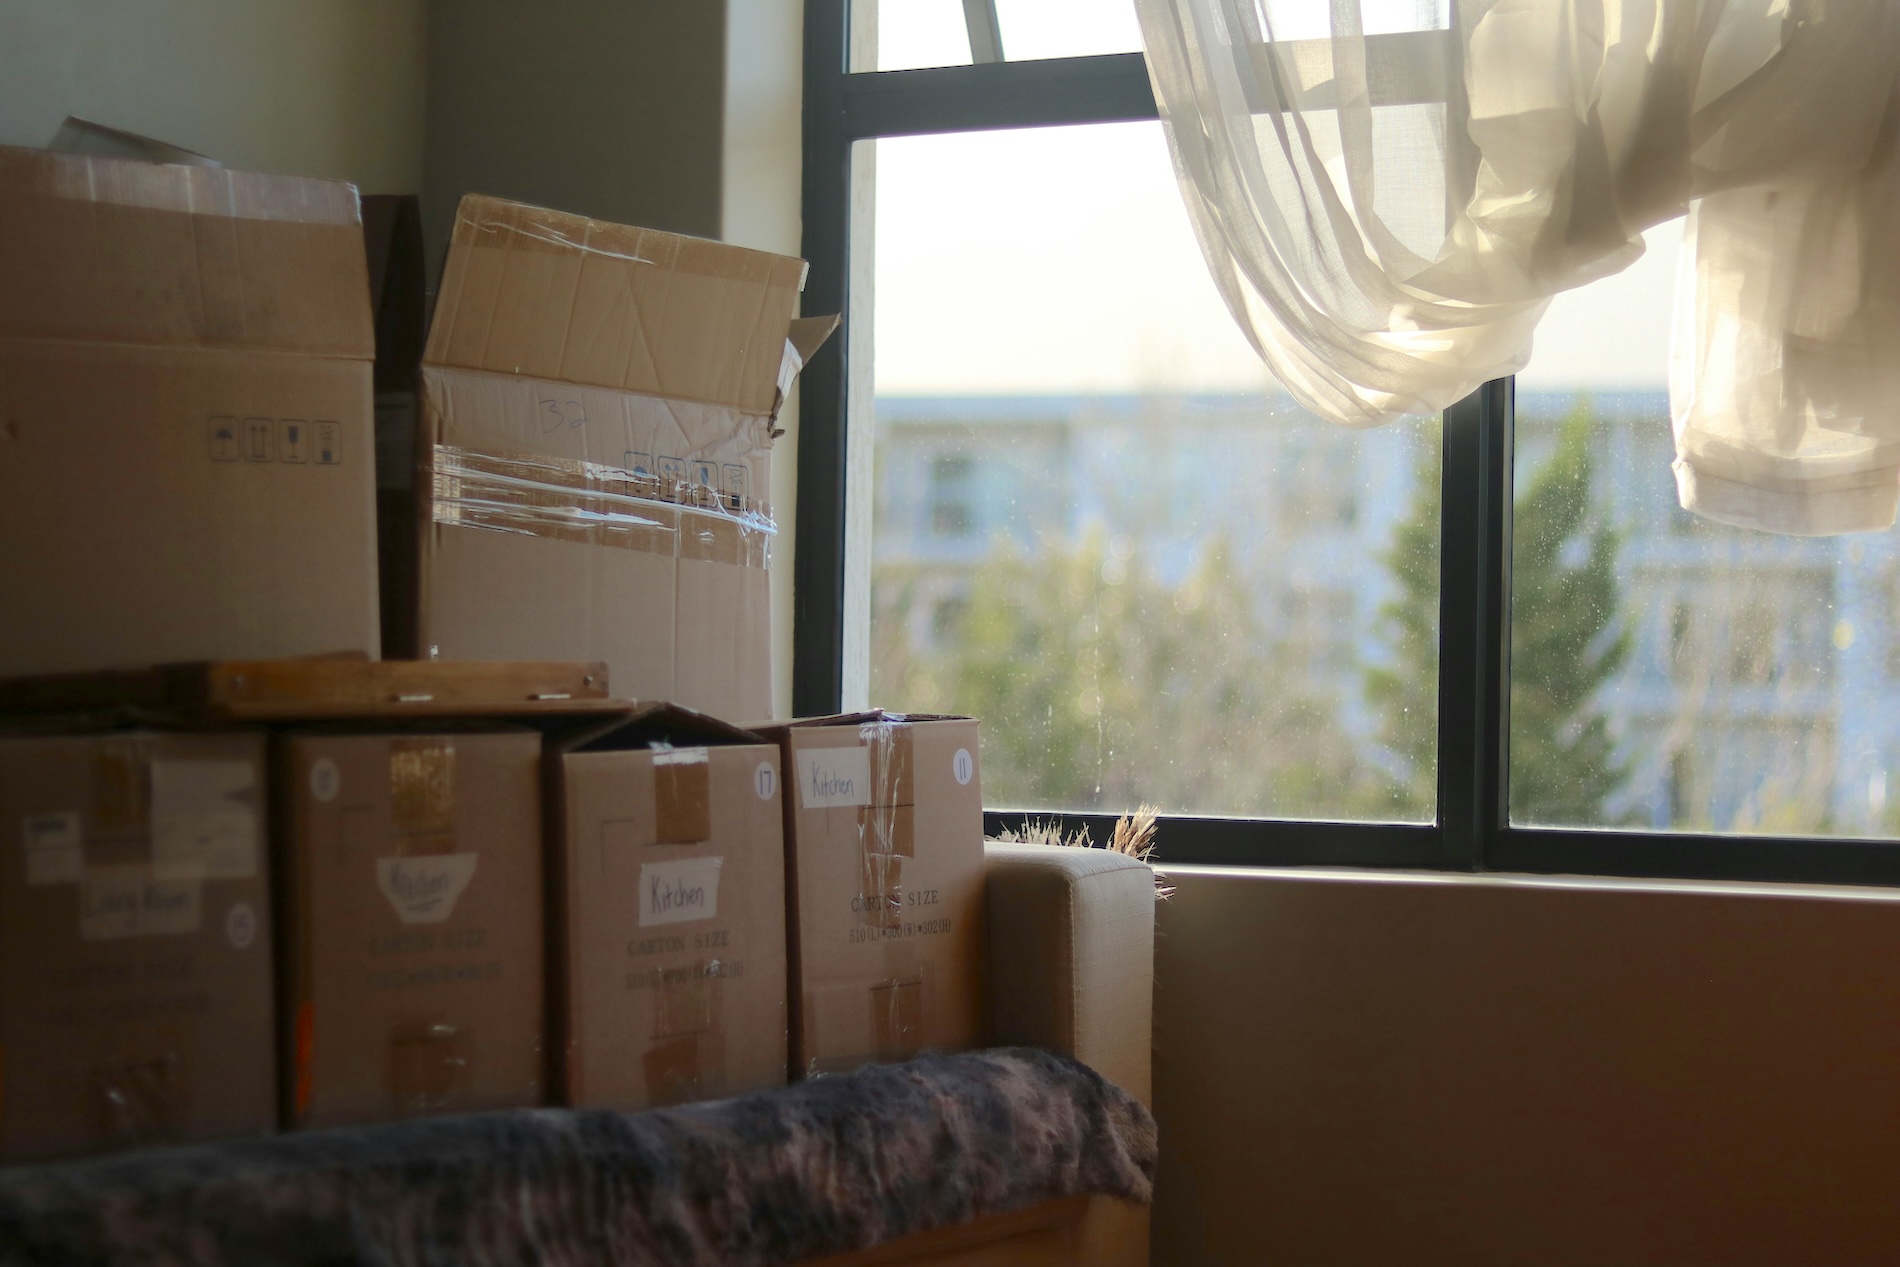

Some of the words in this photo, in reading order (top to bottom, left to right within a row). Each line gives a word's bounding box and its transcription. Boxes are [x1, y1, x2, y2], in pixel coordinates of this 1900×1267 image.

[539, 399, 592, 434] 32
[760, 769, 772, 795] 17
[812, 760, 854, 798] Kitchen
[959, 758, 967, 780] 11
[651, 874, 704, 914] Kitchen
[851, 894, 898, 912] CARTON
[908, 890, 939, 906] SIZE
[626, 935, 686, 957] CARTON
[694, 930, 730, 949] SIZE
